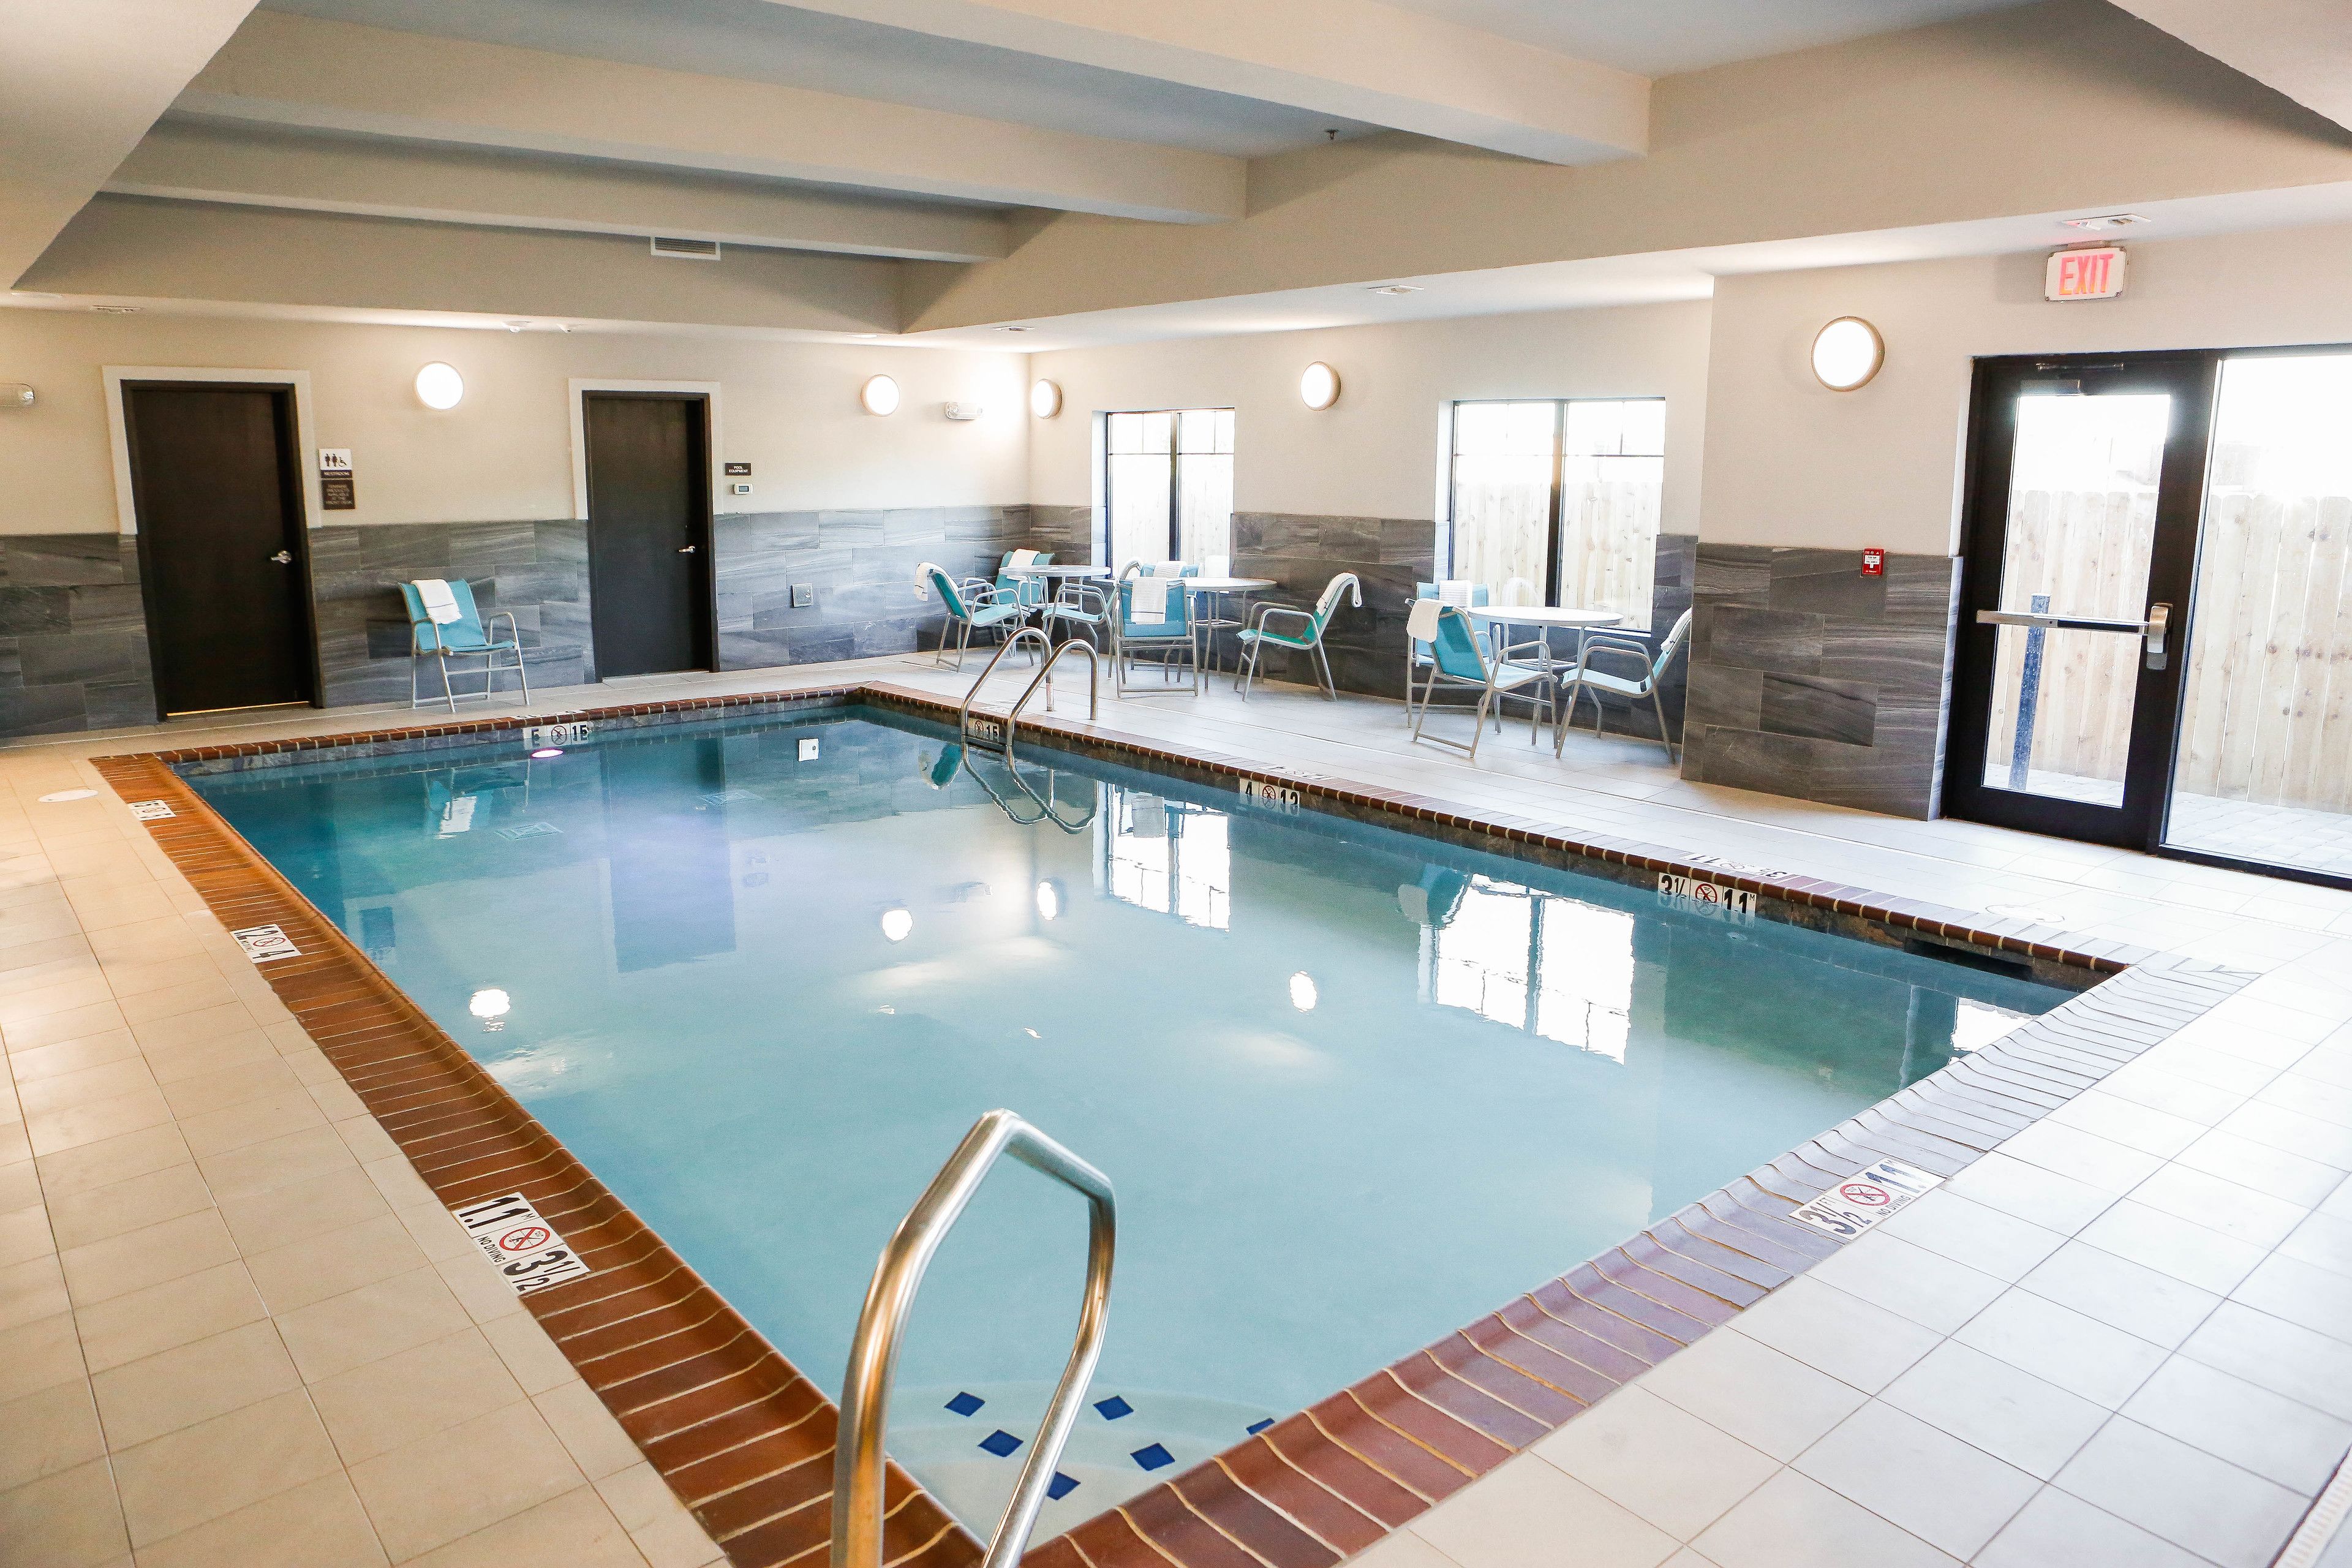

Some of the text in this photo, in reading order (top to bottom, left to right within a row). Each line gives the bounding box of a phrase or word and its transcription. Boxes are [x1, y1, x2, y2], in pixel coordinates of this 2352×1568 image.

[2059, 253, 2115, 296] EXIT
[233, 925, 279, 941] 1.2
[252, 949, 296, 959] 4
[458, 1196, 536, 1230] 1.1 M
[1823, 1197, 1838, 1207] FT
[1875, 1194, 1912, 1217] NO DIVING
[477, 1235, 507, 1263] NO DIVING
